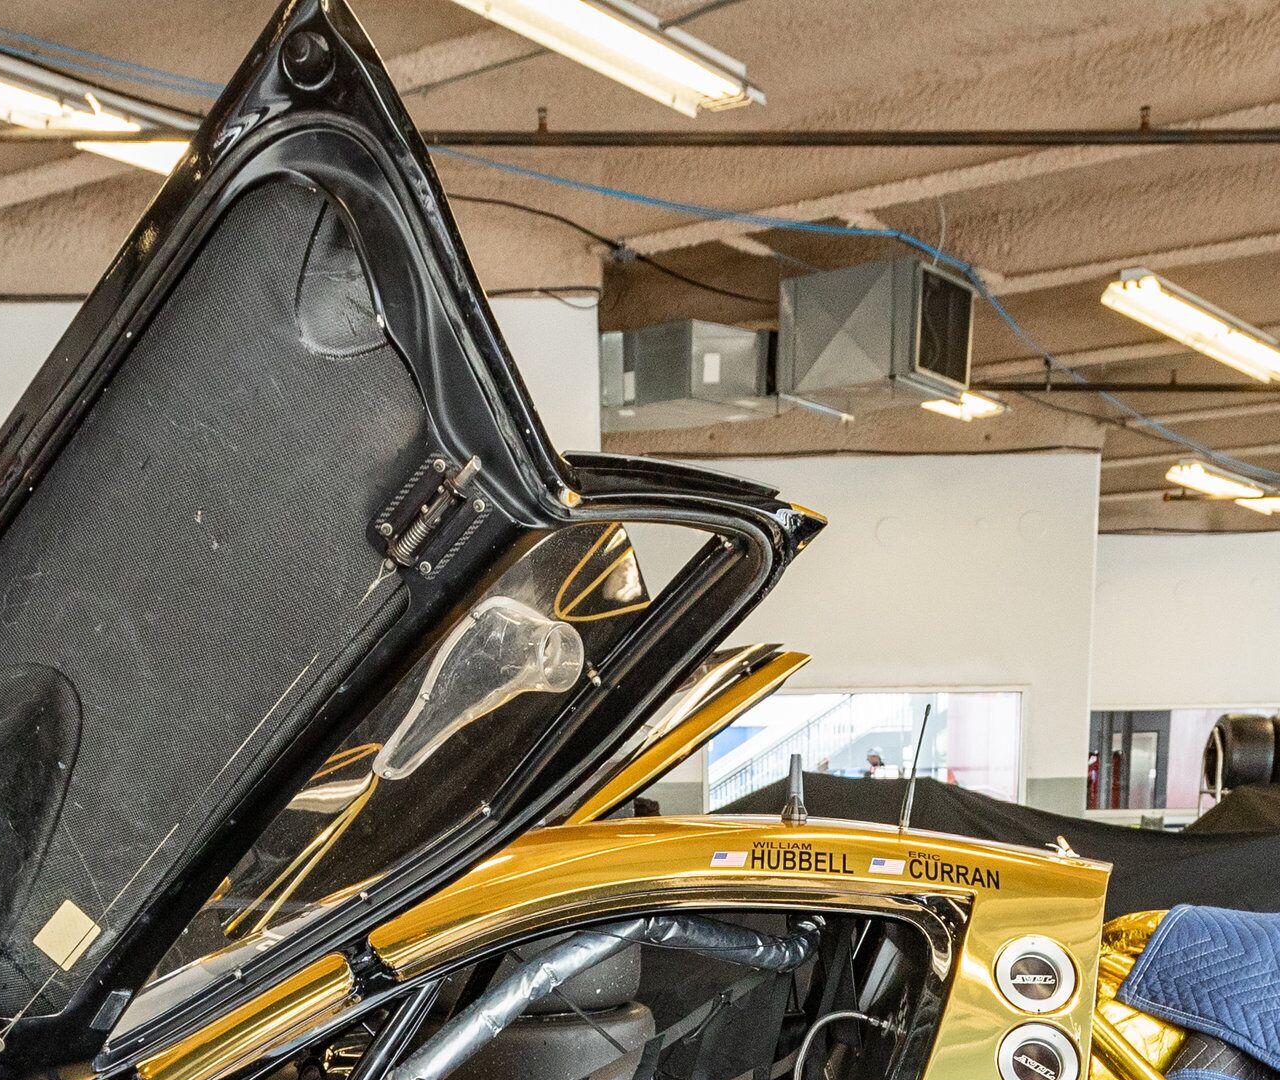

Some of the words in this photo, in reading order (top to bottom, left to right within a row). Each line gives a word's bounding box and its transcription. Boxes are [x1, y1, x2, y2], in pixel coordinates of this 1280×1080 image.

[752, 841, 812, 850] WILLIAM
[751, 849, 854, 874] HUBBELL
[908, 851, 941, 861] ERIC
[909, 858, 1000, 890] CURRAN
